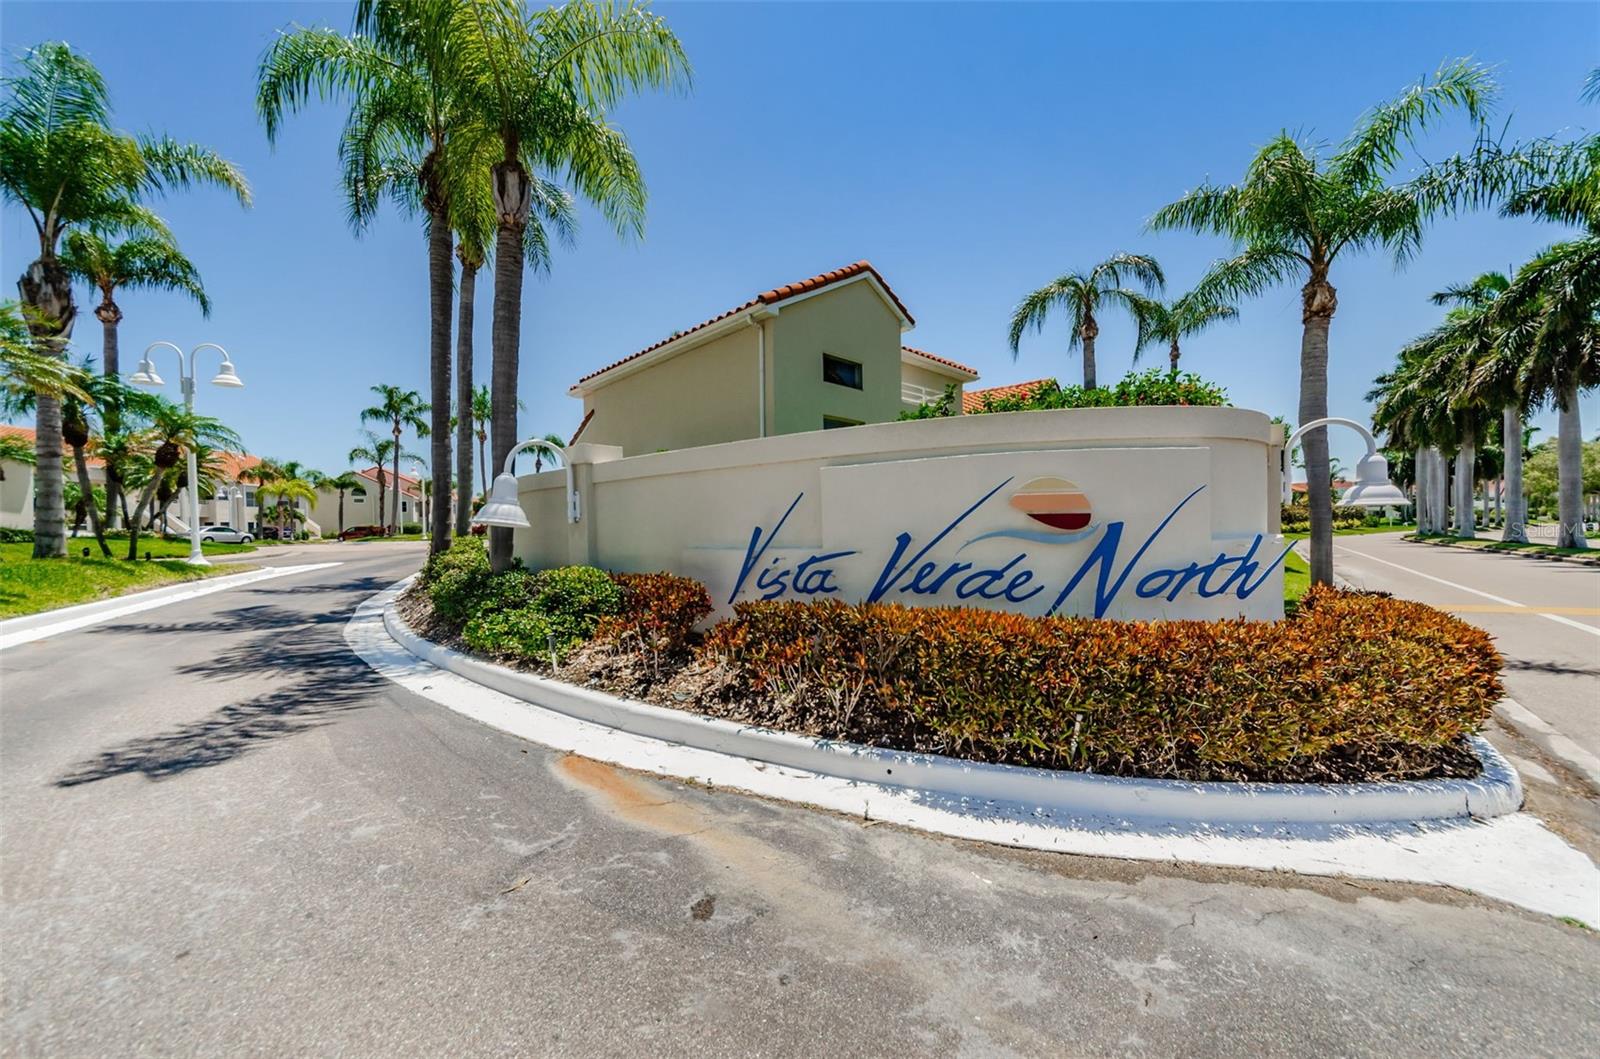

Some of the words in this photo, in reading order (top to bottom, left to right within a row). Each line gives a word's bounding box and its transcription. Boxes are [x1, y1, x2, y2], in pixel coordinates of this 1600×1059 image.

[729, 492, 857, 604] Vista
[867, 476, 1045, 603] Verde
[1044, 484, 1298, 618] North
